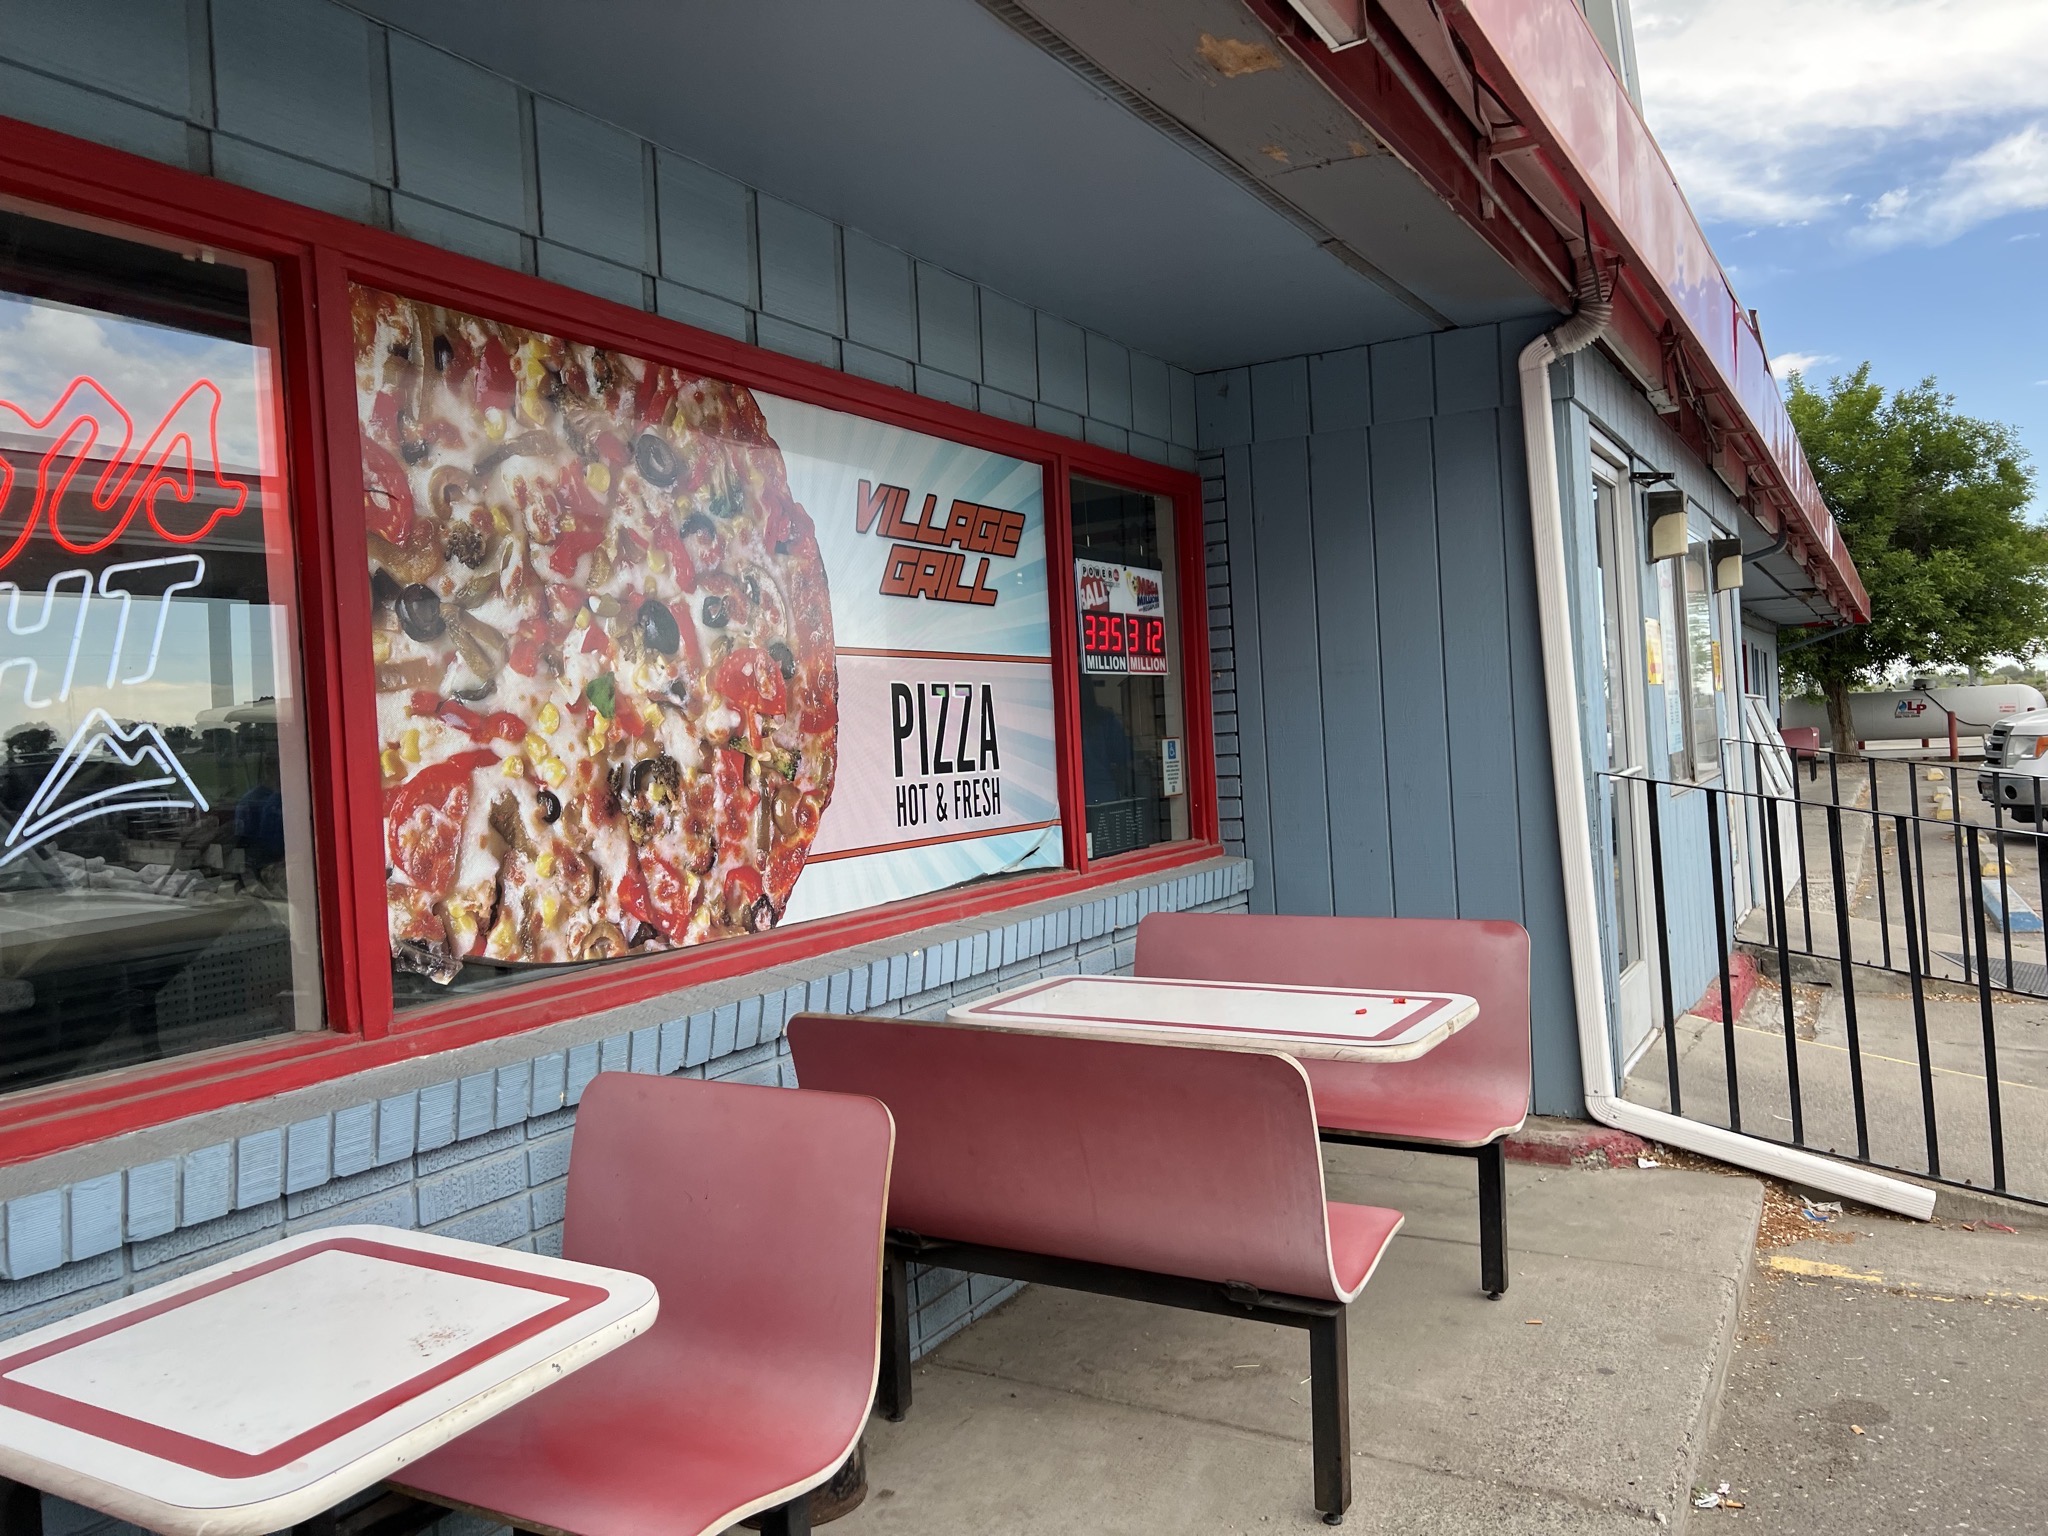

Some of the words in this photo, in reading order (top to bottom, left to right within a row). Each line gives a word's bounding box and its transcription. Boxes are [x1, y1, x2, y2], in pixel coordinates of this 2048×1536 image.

[855, 478, 1026, 558] VILLAGE
[879, 543, 998, 606] GRILL
[1082, 565, 1113, 580] POWER
[1137, 576, 1159, 595] MEGA
[1081, 581, 1108, 610] BALL
[1085, 615, 1121, 651] 335
[1129, 619, 1162, 653] 312
[1086, 654, 1126, 671] MILLION
[1130, 656, 1166, 671] MILLION
[890, 682, 1000, 778] PIZZA
[896, 783, 929, 827] HOT
[936, 782, 948, 822] &
[954, 777, 1001, 820] FRESH
